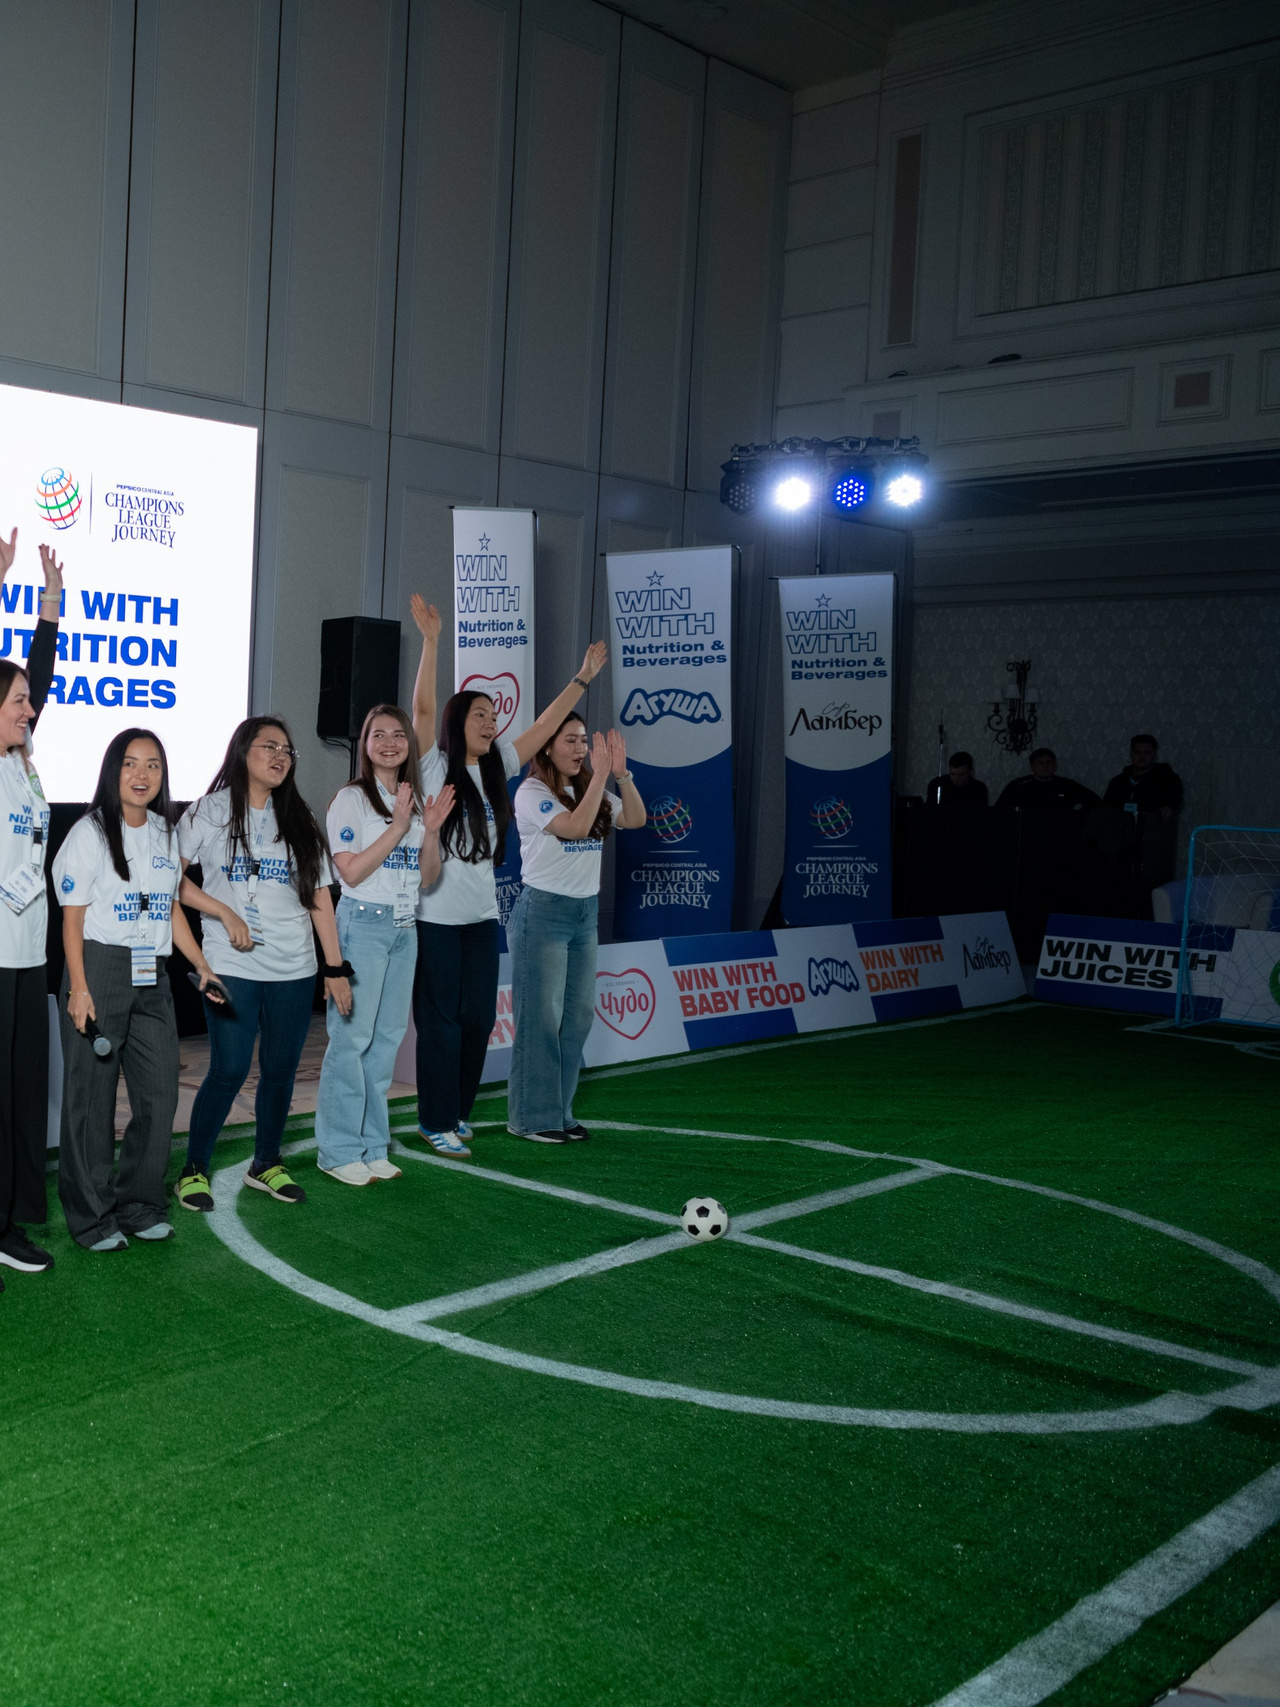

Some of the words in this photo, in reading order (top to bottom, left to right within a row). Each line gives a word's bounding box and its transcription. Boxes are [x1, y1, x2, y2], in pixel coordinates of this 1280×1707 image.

[116, 484, 141, 492] PEPSICO
[105, 492, 184, 516] CHAMPIONS
[118, 509, 171, 529] LEAGUE
[111, 524, 176, 549] JOURNEY
[456, 555, 507, 581] WIN
[81, 590, 178, 626] WITH
[457, 586, 520, 613] WITH
[615, 587, 691, 613] WIN
[458, 620, 514, 633] Nutrition
[516, 619, 526, 630] &
[615, 612, 714, 639] WITH
[786, 609, 855, 631] WIN
[458, 634, 528, 649] Beverages
[622, 642, 705, 655] Nutrition
[711, 640, 725, 651] &
[786, 632, 877, 654] WITH
[622, 654, 727, 667] Beverages
[791, 658, 867, 669] Nutrition
[873, 657, 886, 667] &
[791, 670, 888, 680] Beverages
[789, 708, 882, 736] Ламбер
[631, 870, 720, 882] CHAMPIONS
[795, 863, 878, 874] CHAMPIONS
[810, 874, 864, 884] LEAGUE
[646, 882, 705, 894] LEAGUE
[803, 885, 869, 898] JOURNEY
[639, 894, 711, 909] JOURNEY
[859, 947, 899, 971] WIN
[901, 944, 945, 966] WITH
[1046, 939, 1112, 962] WIN
[1124, 947, 1217, 973] WITH
[672, 967, 718, 992] WIN
[722, 961, 777, 986] WITH
[865, 968, 919, 993] DAIRY
[1040, 960, 1173, 989] JUICES
[679, 990, 740, 1017] BABY
[746, 982, 805, 1009] FOOD
